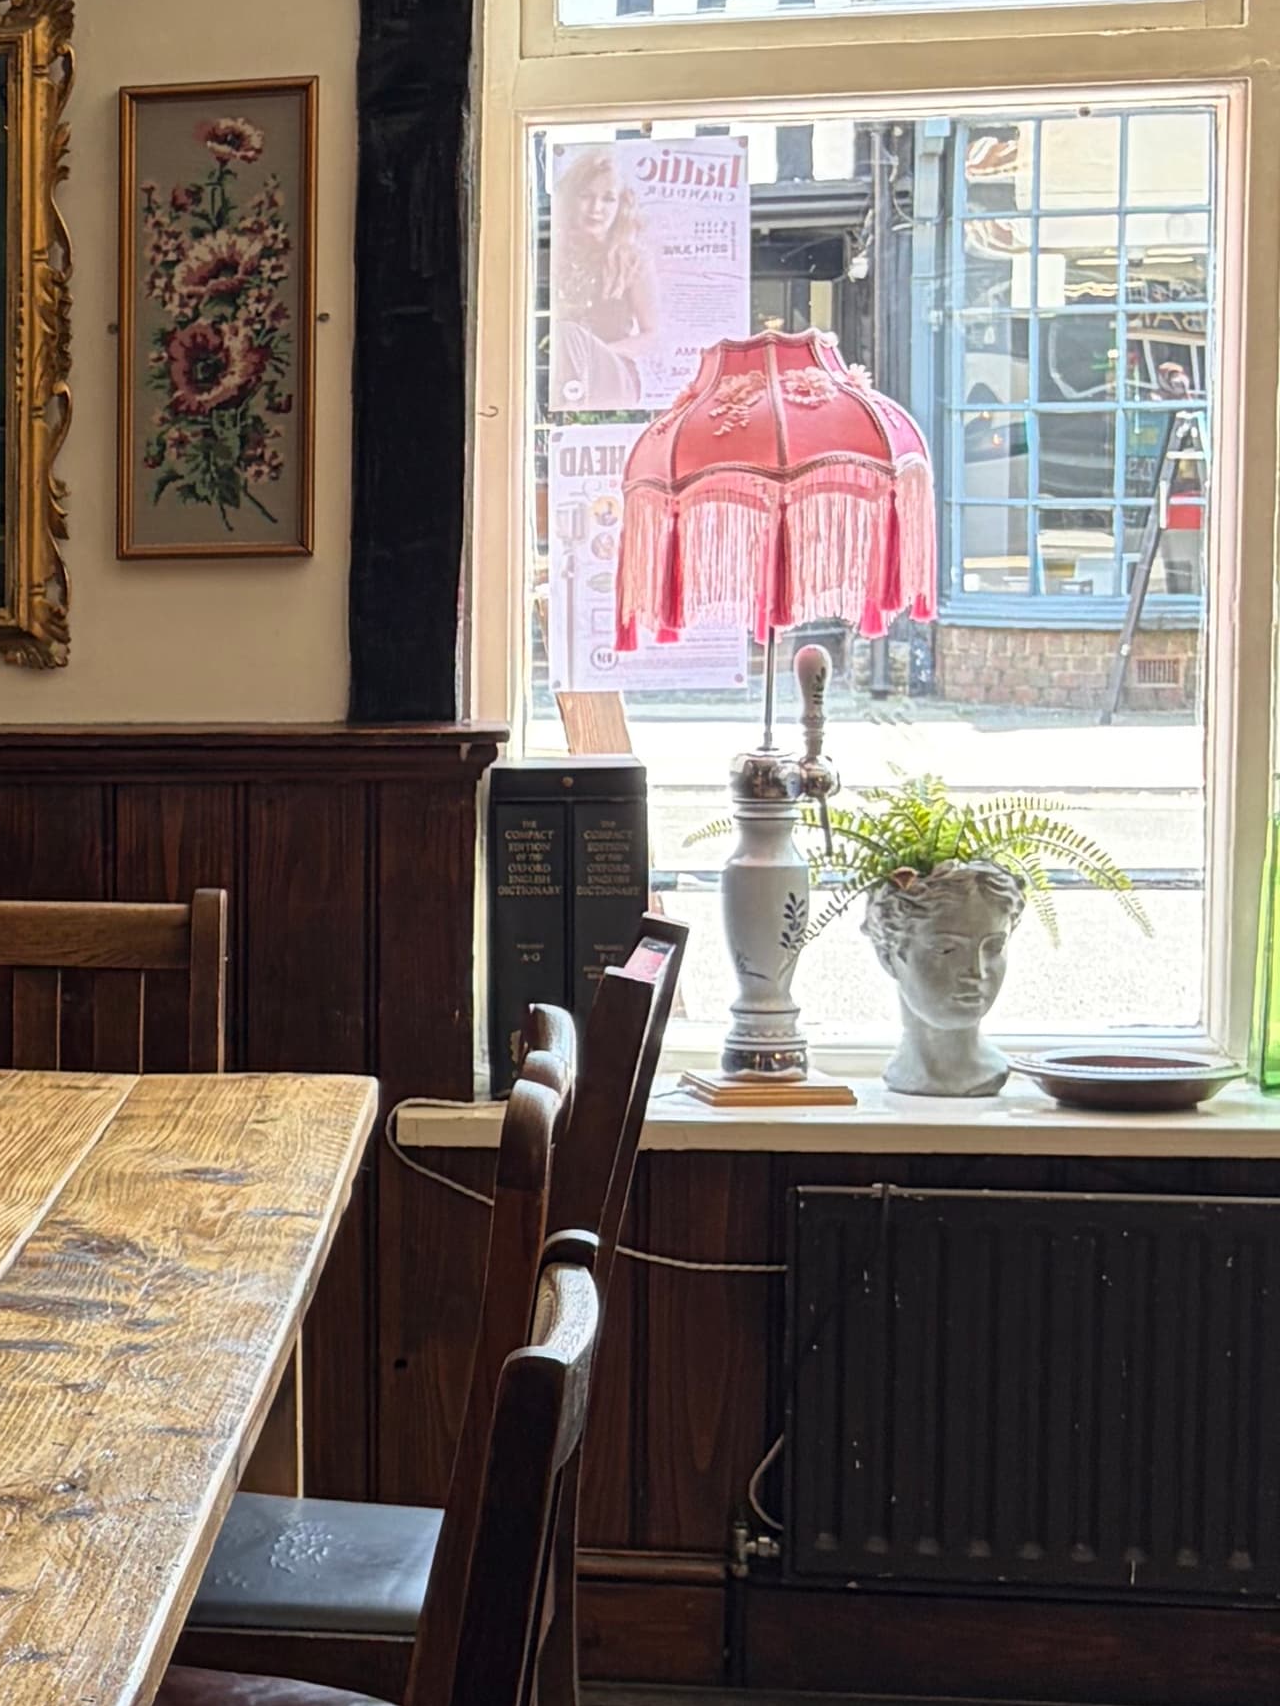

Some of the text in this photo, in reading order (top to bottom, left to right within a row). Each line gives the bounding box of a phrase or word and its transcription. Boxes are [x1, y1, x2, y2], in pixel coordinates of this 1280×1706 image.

[504, 830, 555, 840] COMPACT
[583, 830, 633, 840] COMPACT
[508, 842, 552, 852] EDITION
[587, 842, 630, 852] EDITION
[508, 864, 552, 873] OXFORD
[586, 864, 631, 873] OXFORD
[509, 875, 551, 884] ENGLISH
[587, 875, 630, 884] ENGLISH
[497, 885, 562, 895] DICTIONARY
[576, 885, 641, 895] DICTIONARY
